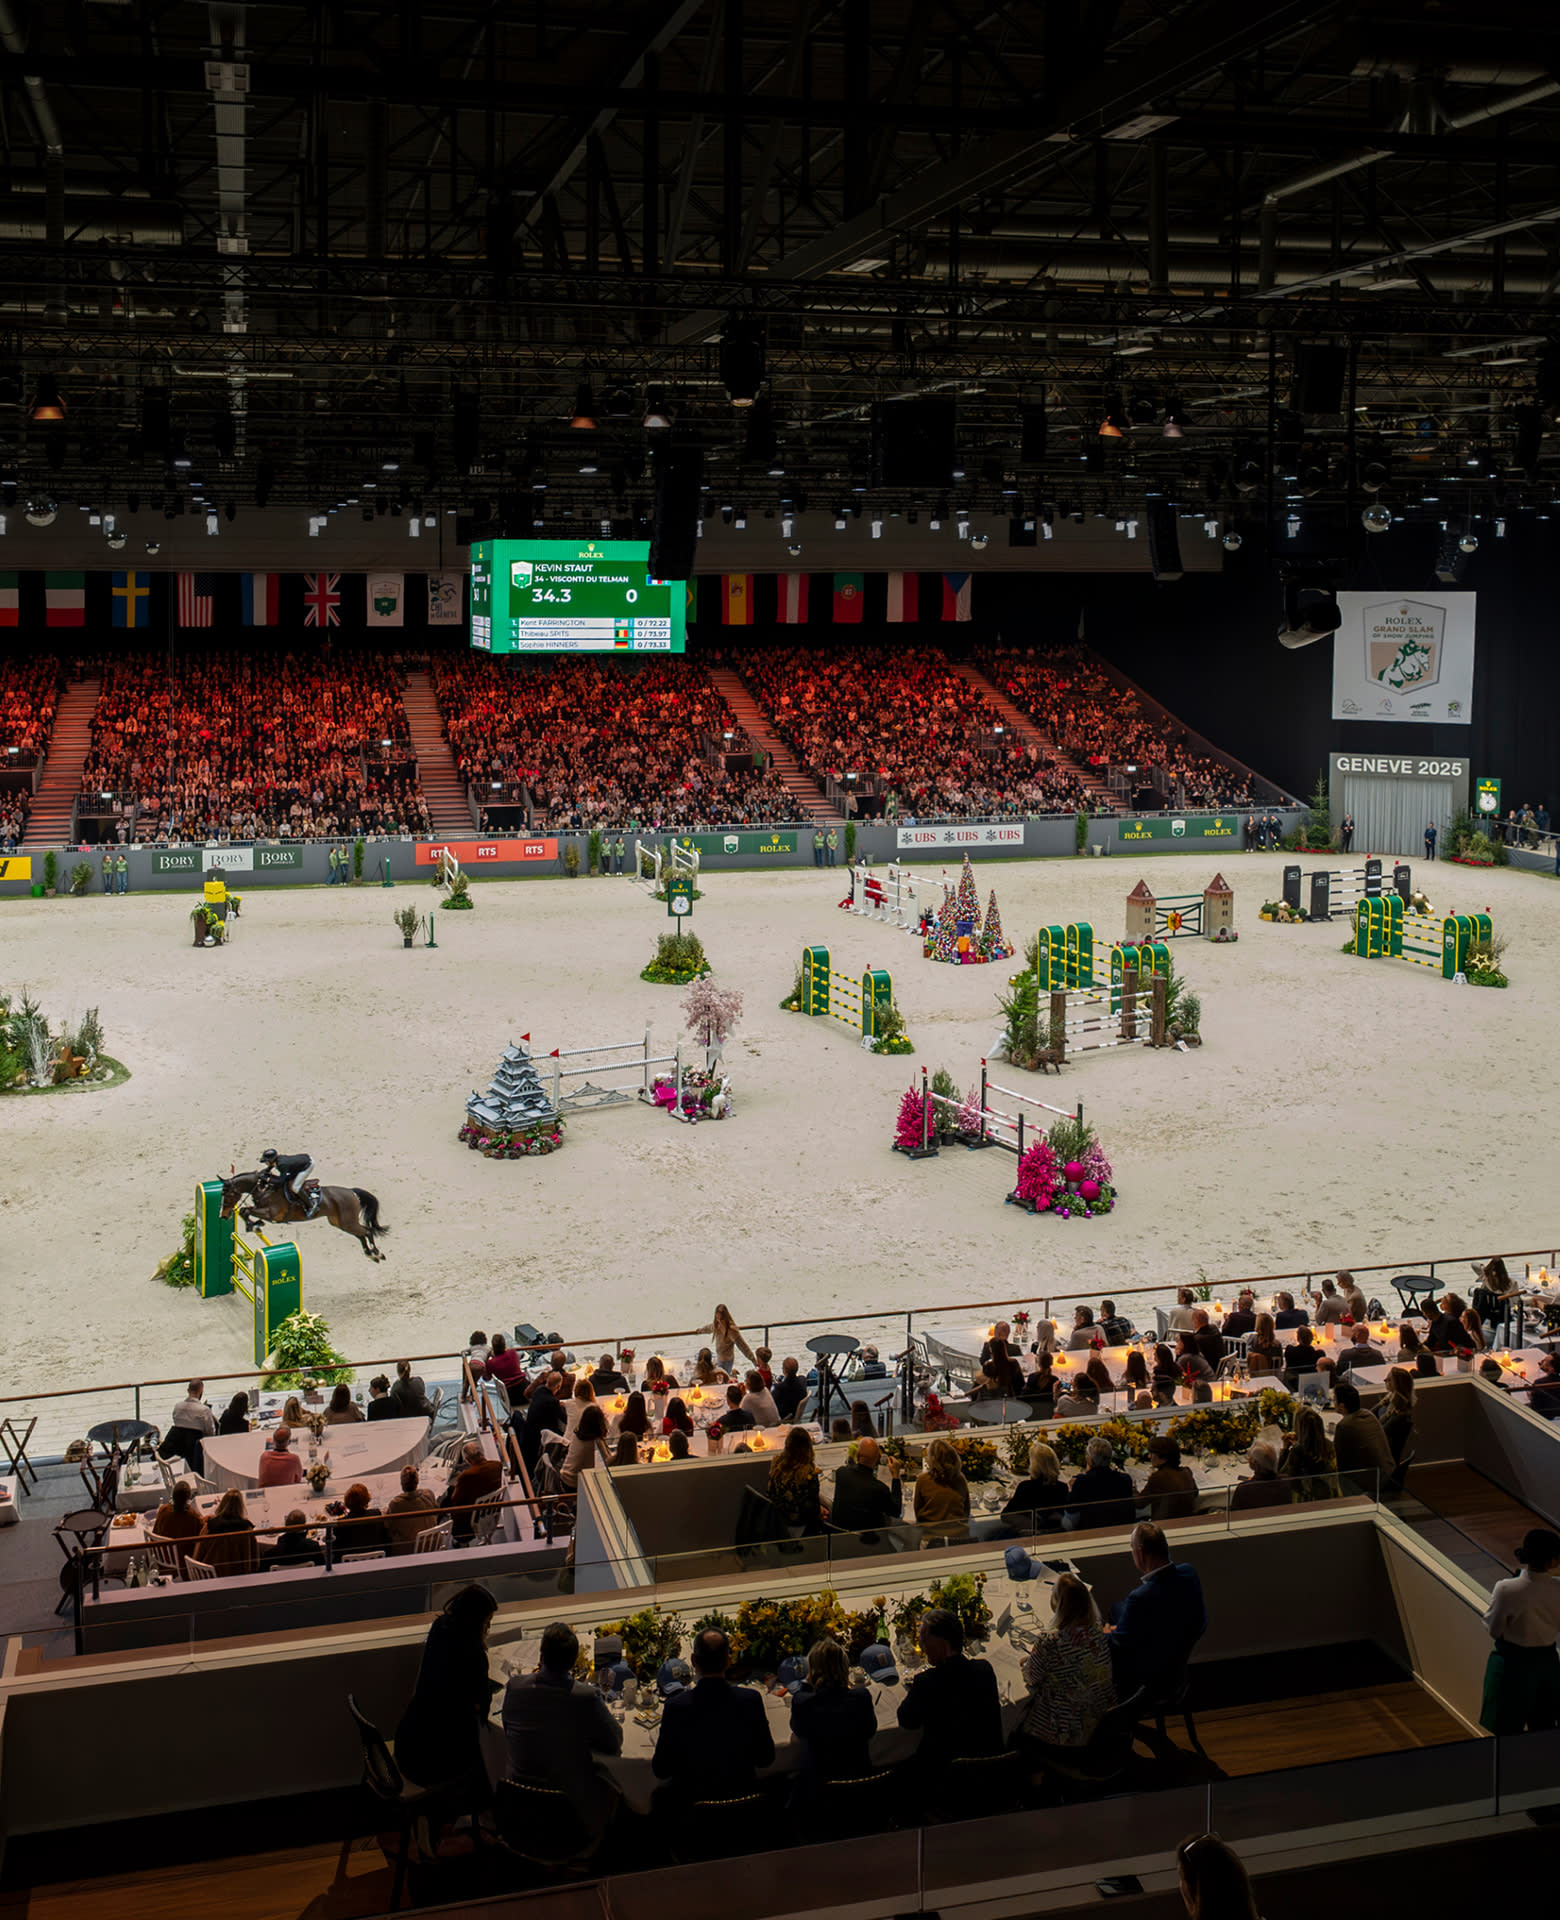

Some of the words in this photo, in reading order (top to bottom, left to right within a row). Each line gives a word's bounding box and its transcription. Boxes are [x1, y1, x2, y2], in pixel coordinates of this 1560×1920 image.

[535, 564, 562, 572] KEVIN
[564, 564, 593, 572] STAUT
[532, 588, 571, 602] 34.3
[626, 589, 638, 603] 0
[1385, 617, 1422, 625] ROLEX
[1336, 757, 1412, 774] GENEVE
[1418, 761, 1462, 776] 2025
[914, 832, 936, 842] UBS
[956, 831, 979, 841] UBS
[998, 830, 1020, 840] UBS
[1124, 831, 1152, 840] ROLEX
[1204, 828, 1232, 836] ROLEX
[478, 847, 496, 856] RTS
[525, 845, 543, 855] RTS
[759, 844, 790, 853] ROLEX
